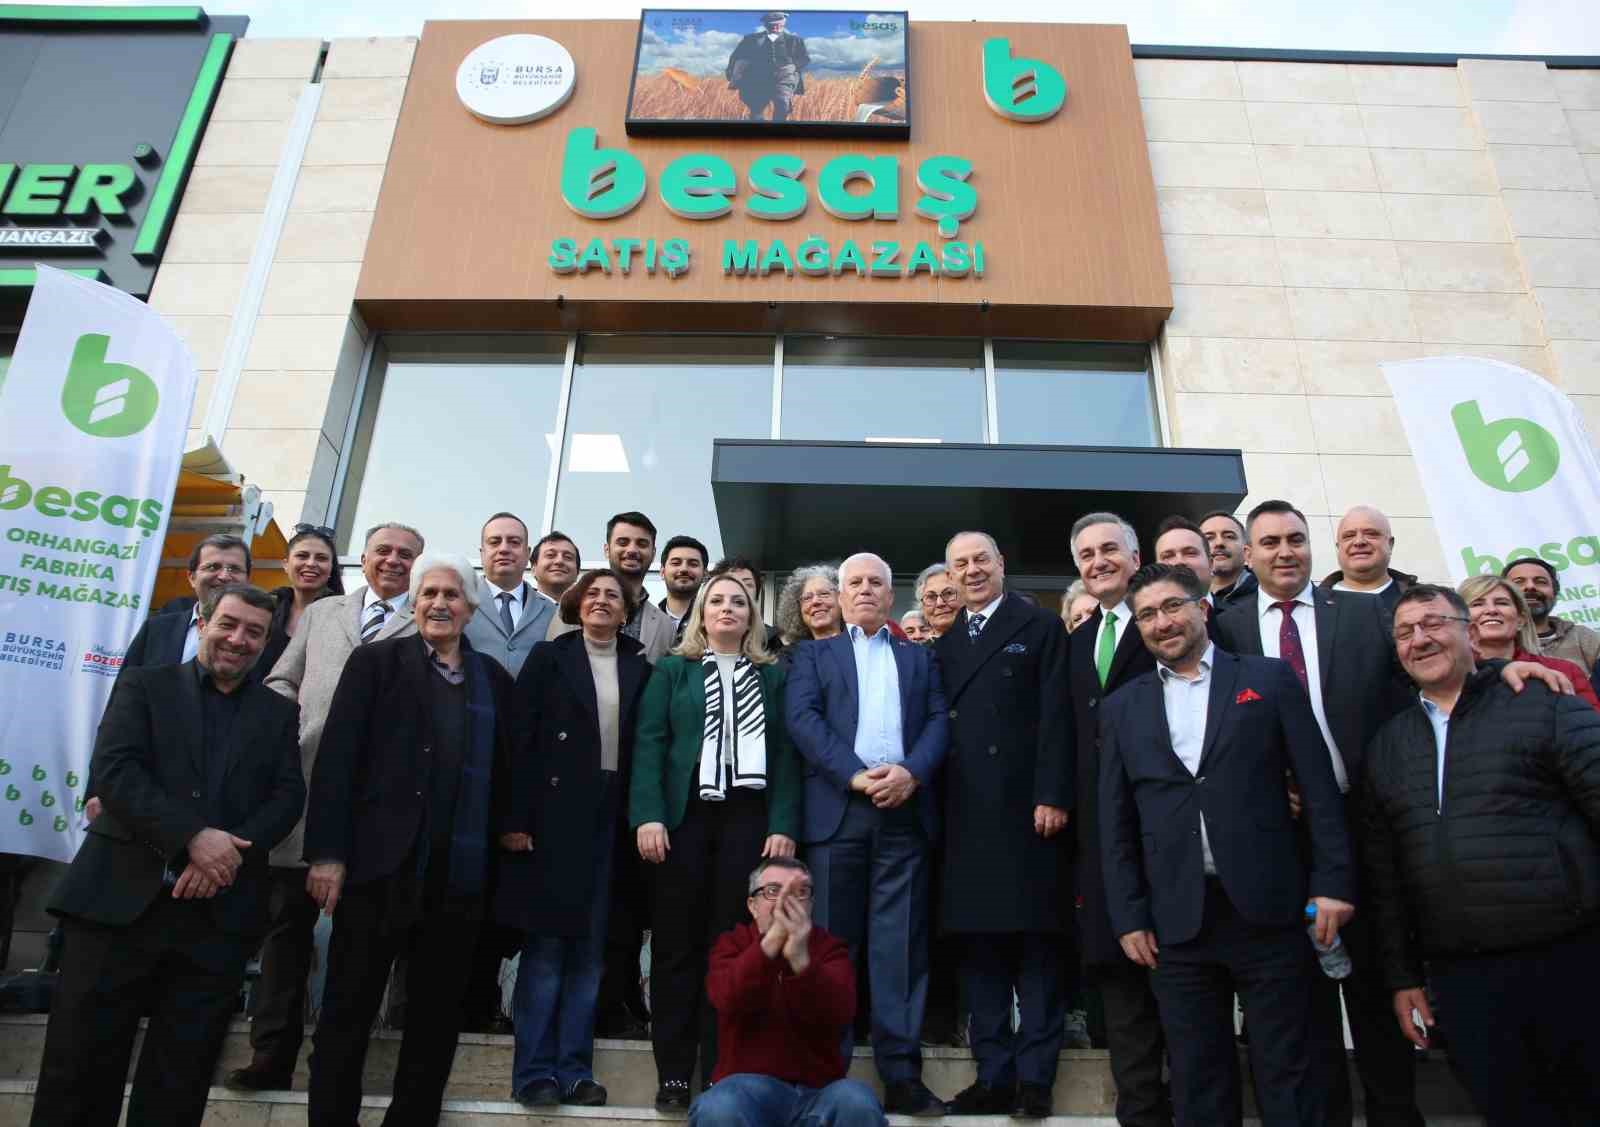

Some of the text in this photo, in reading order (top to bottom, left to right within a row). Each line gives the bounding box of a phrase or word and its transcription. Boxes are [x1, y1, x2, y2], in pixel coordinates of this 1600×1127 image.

[560, 127, 978, 239] besaş
[548, 234, 985, 278] SATIŞ MAĞAZASI
[6, 527, 140, 560] ORHANGAZİ
[20, 553, 114, 581] FABRİKA
[5, 632, 66, 652] BURSA
